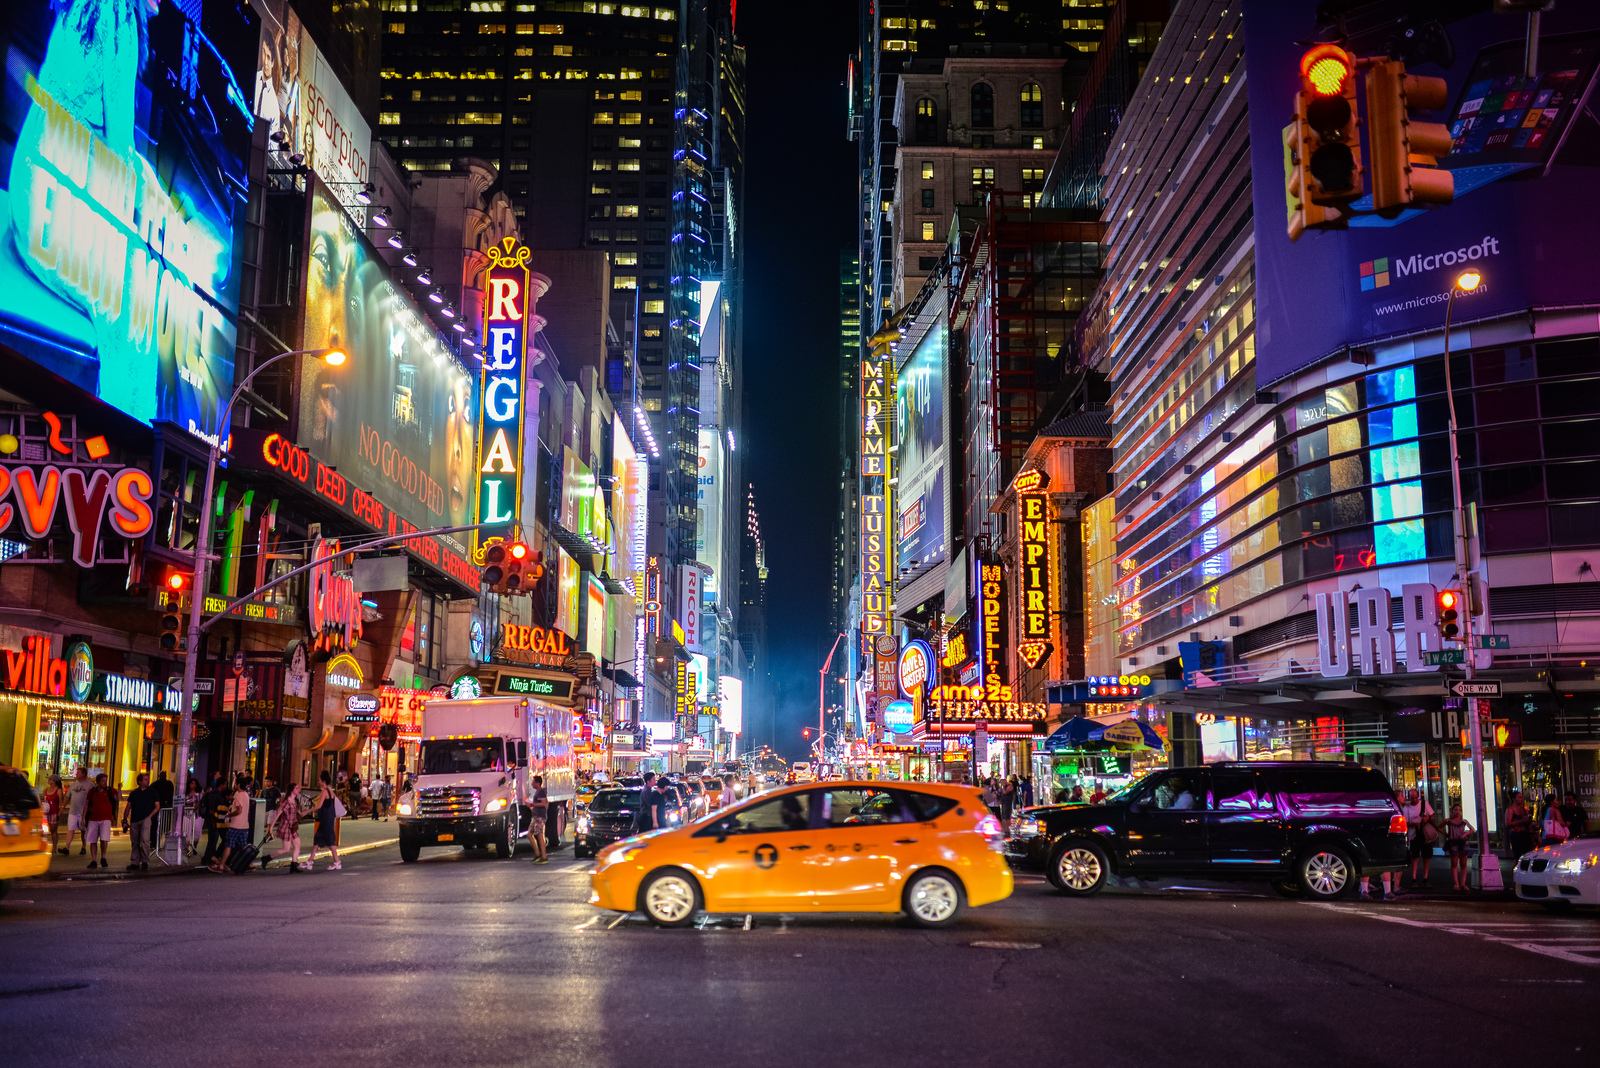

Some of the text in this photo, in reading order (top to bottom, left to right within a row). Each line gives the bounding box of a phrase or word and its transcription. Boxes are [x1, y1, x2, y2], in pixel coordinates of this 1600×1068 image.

[307, 84, 368, 184] scorpion
[1396, 236, 1500, 278] Microsoft
[482, 278, 522, 525] REGAL
[864, 361, 884, 474] MADAME
[358, 421, 444, 516] NO GOOD DEED
[1016, 474, 1040, 488] amc
[263, 433, 310, 484] GOOD
[316, 462, 347, 506] DEED
[352, 488, 385, 529] OPENS
[388, 512, 397, 538] IN
[441, 556, 482, 593] EVERYWHERE
[1024, 499, 1045, 634] EMPIRE
[205, 597, 227, 613] FRESH
[245, 603, 264, 618] FRESH
[265, 607, 278, 620] MEX
[686, 570, 698, 646] RICOH
[503, 623, 570, 656] REGAL
[981, 565, 1001, 689] MODELL'S
[1489, 637, 1497, 646] 8
[5, 635, 68, 697] villa
[878, 661, 896, 674] EAT
[1026, 645, 1039, 660] 25
[1432, 654, 1440, 663] W
[1442, 653, 1454, 662] 42
[106, 674, 154, 708] STROMBOLI
[510, 677, 529, 692] Ninja
[879, 682, 896, 691] PLAY
[931, 685, 1013, 701] amc 25
[1458, 684, 1495, 693] ONE WAY
